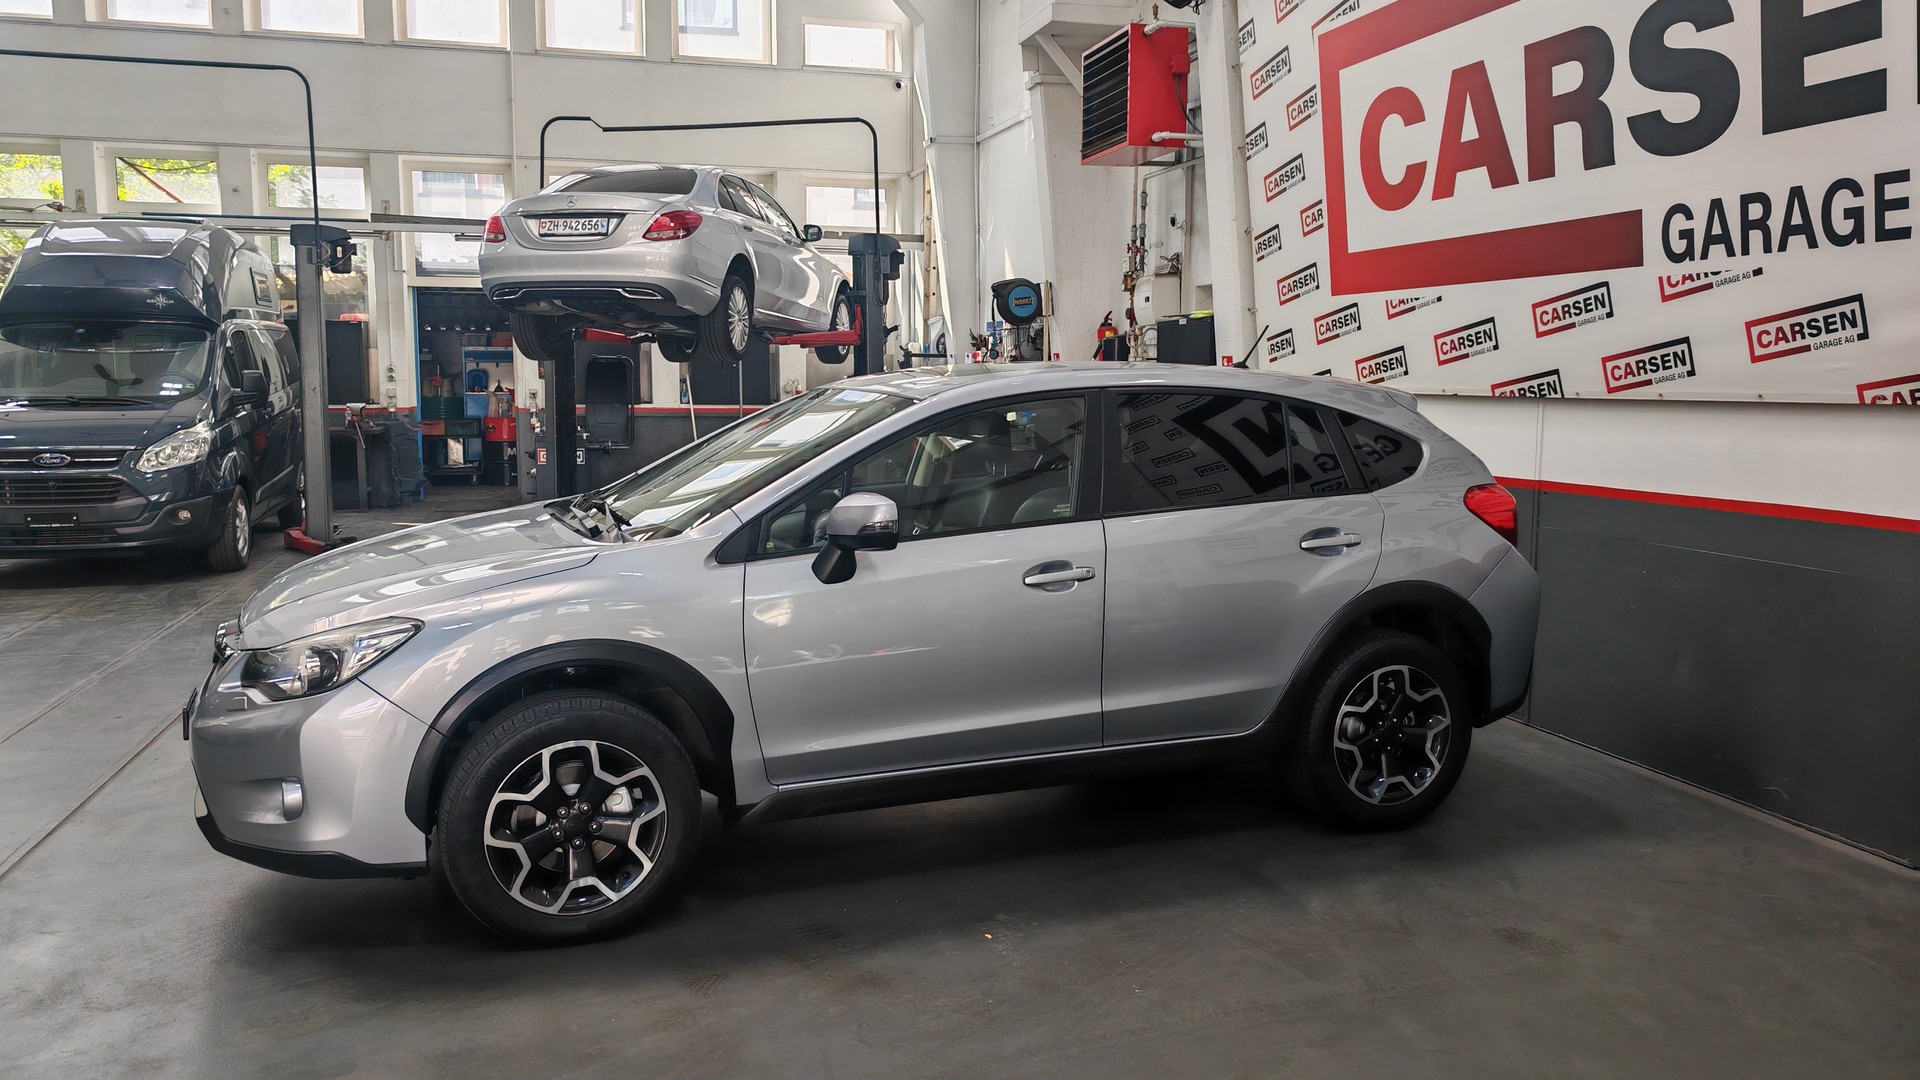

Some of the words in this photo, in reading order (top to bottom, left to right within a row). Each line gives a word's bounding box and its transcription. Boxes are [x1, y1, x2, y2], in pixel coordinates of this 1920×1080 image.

[1254, 55, 1288, 90] CARSEN
[1360, 0, 1920, 212] CARSE
[1267, 162, 1302, 193] CARSEN
[1304, 208, 1324, 227] CAR
[1661, 168, 1913, 264] GARAGE
[1281, 270, 1316, 297] CARSEN
[1714, 275, 1741, 288] GARAGE
[1741, 271, 1751, 280] AG
[1539, 292, 1606, 326] CARSEN
[1577, 316, 1597, 327] GARAGE
[1318, 311, 1357, 336] CARSEN
[1756, 308, 1858, 349] CARSEN
[1440, 327, 1493, 356] CARSEN
[1813, 337, 1843, 351] GARAGE
[1844, 334, 1855, 344] AG
[1360, 355, 1404, 379] CARSEN
[1610, 349, 1687, 382] CARSEN
[1654, 374, 1676, 384] GARAGE
[39, 456, 61, 465] Ford
